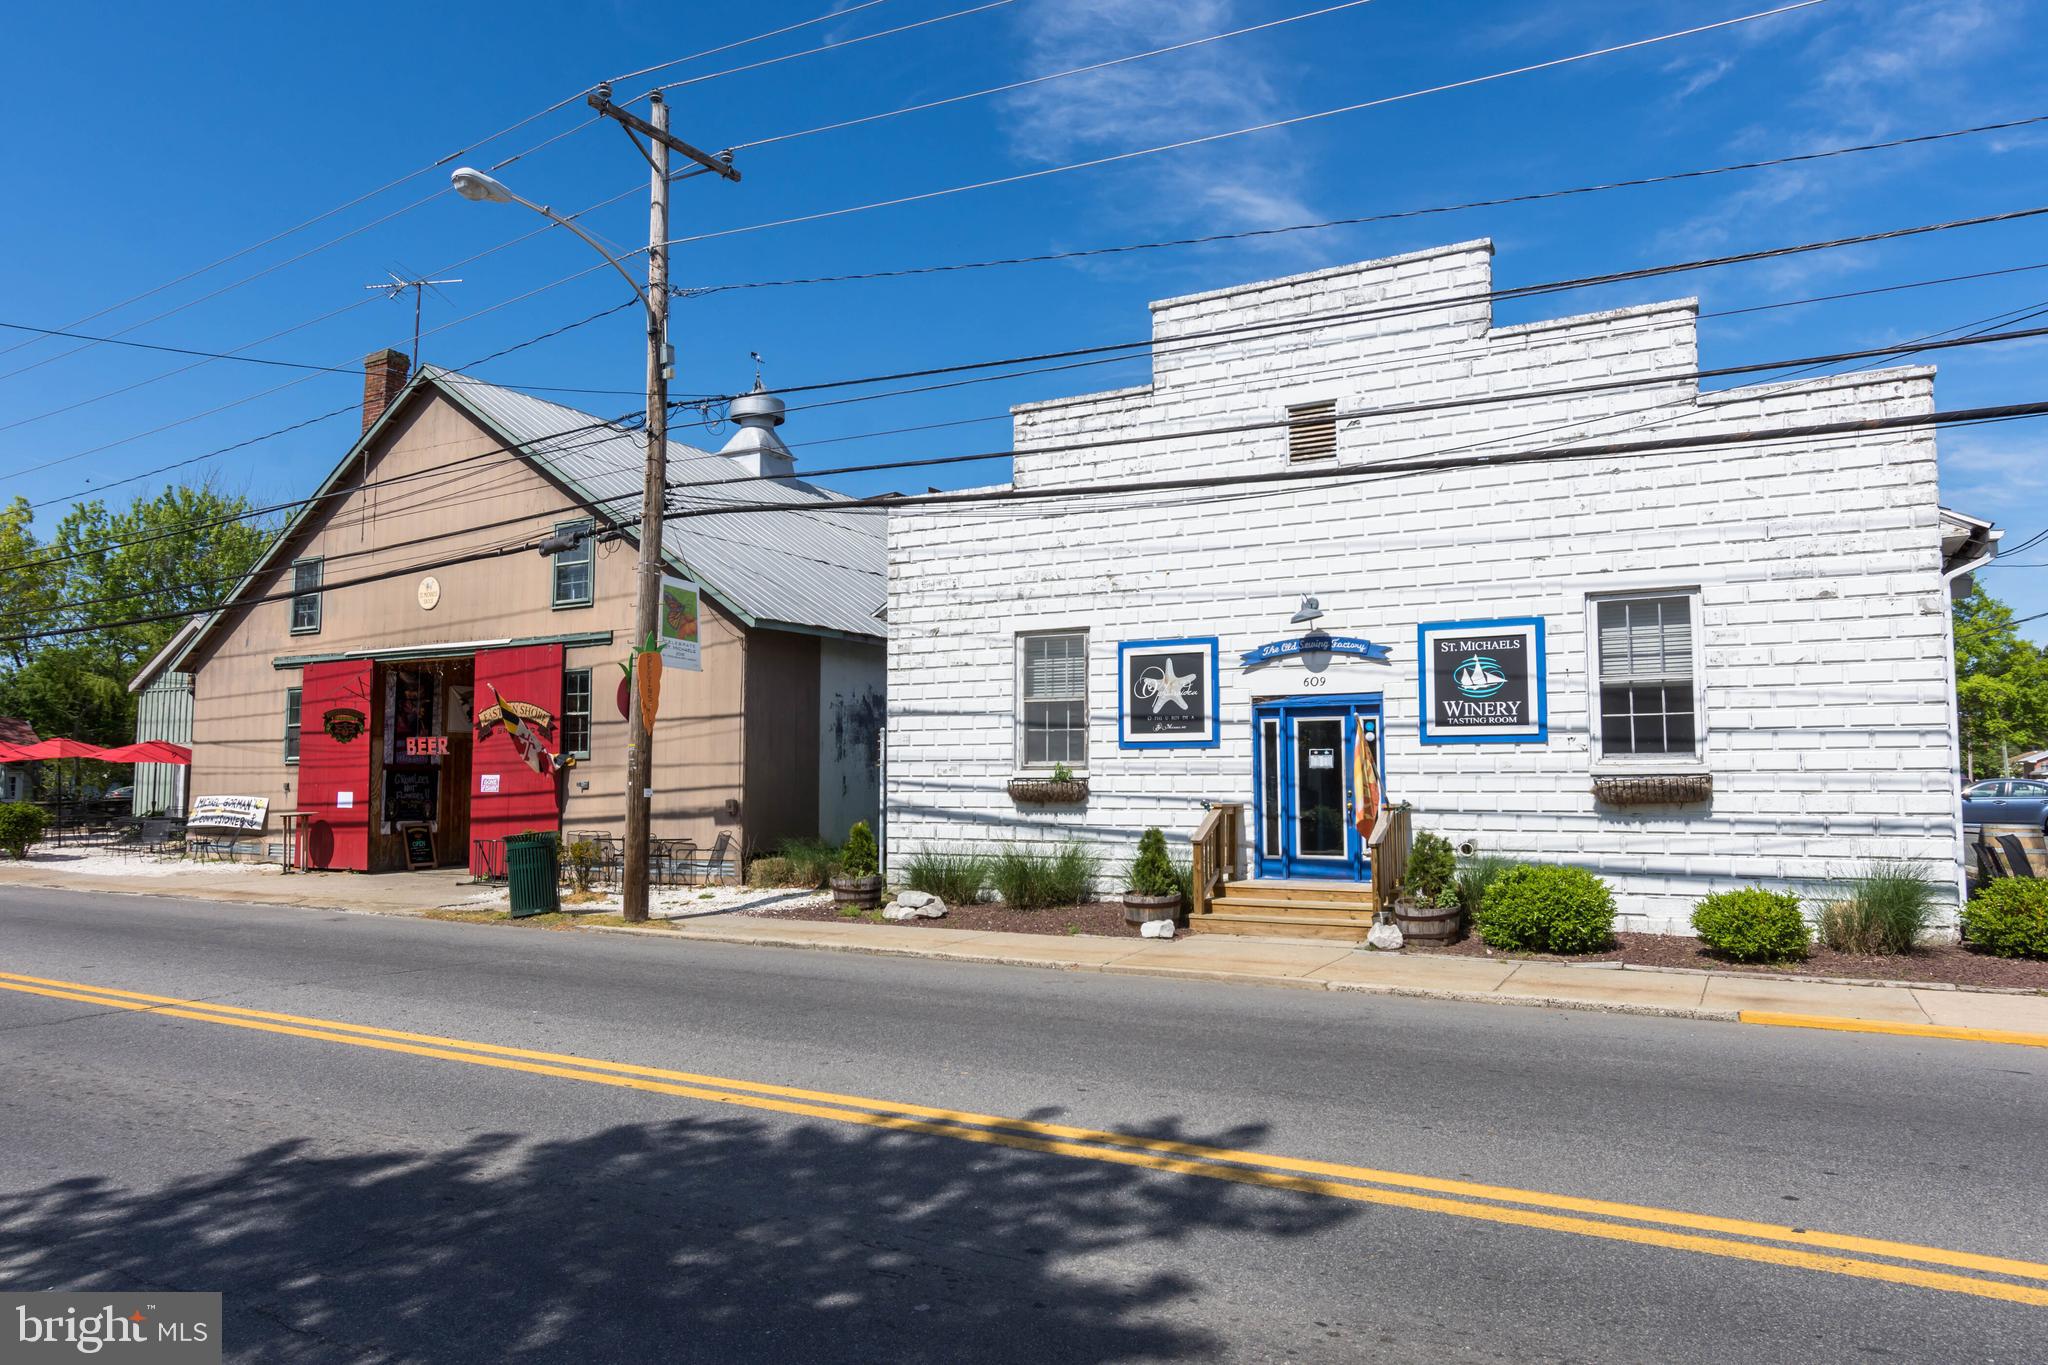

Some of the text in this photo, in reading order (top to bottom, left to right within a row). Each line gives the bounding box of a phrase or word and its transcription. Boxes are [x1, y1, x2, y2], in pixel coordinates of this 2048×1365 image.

[1262, 638, 1366, 656] The Old Sewing Factory
[1441, 640, 1520, 652] ST. MICHAELS
[1304, 676, 1326, 687] 609
[484, 704, 547, 721] EASTN SHORE
[1443, 700, 1521, 717] WINERY
[1448, 716, 1517, 725] TASTING ROOM
[406, 736, 450, 756] BEER
[222, 798, 252, 810] GORMAN
